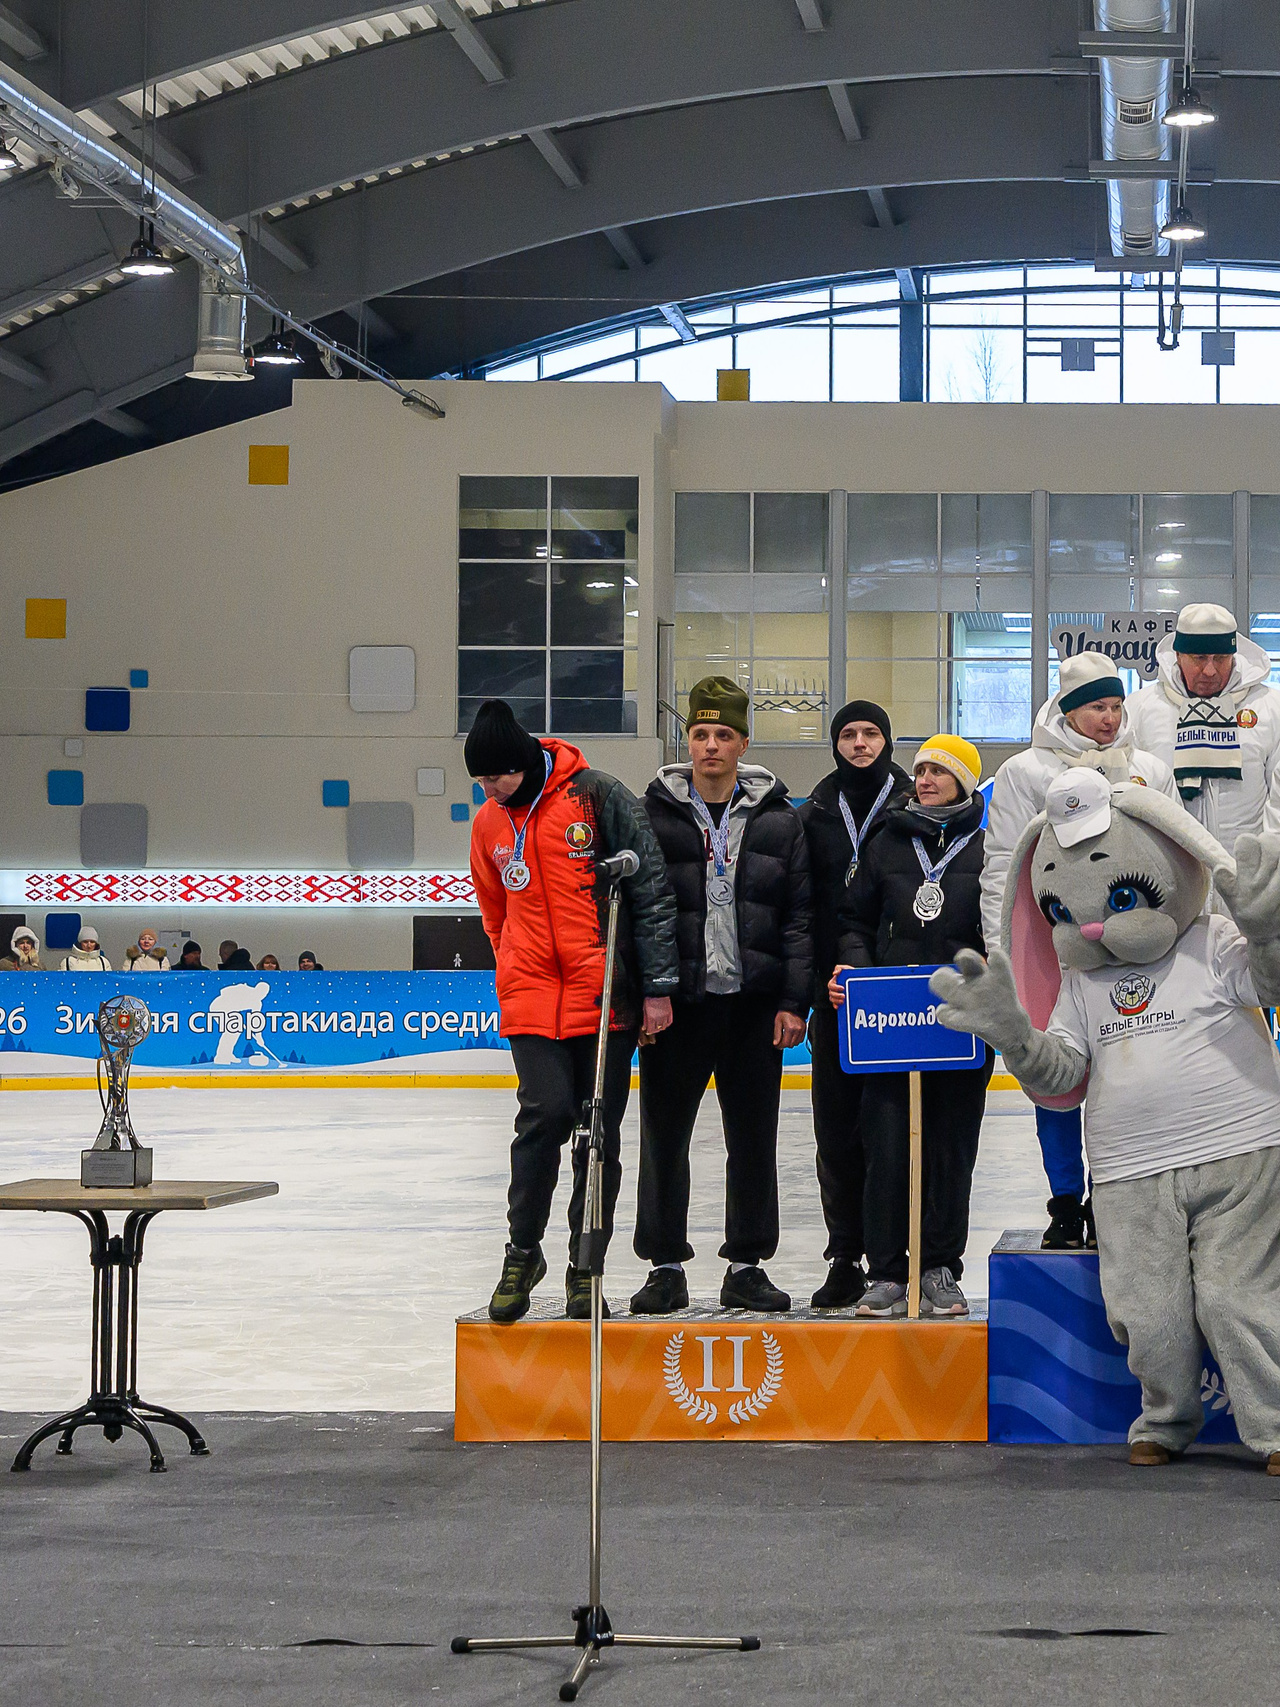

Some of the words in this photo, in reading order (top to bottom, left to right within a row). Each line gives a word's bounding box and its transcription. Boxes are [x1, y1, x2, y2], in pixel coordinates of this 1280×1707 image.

[1111, 619, 1173, 633] КАФЕ
[1177, 729, 1206, 743] БЕЛЫЕ
[1207, 730, 1236, 742] ТИГРЫ
[188, 1011, 394, 1040] спартакиада
[403, 1011, 499, 1040] среди
[854, 1005, 943, 1033] Агрохолд
[1099, 1017, 1133, 1036] БЕЛЫЕ
[1134, 1009, 1175, 1026] ТИГРЫ
[695, 1336, 751, 1392] II
